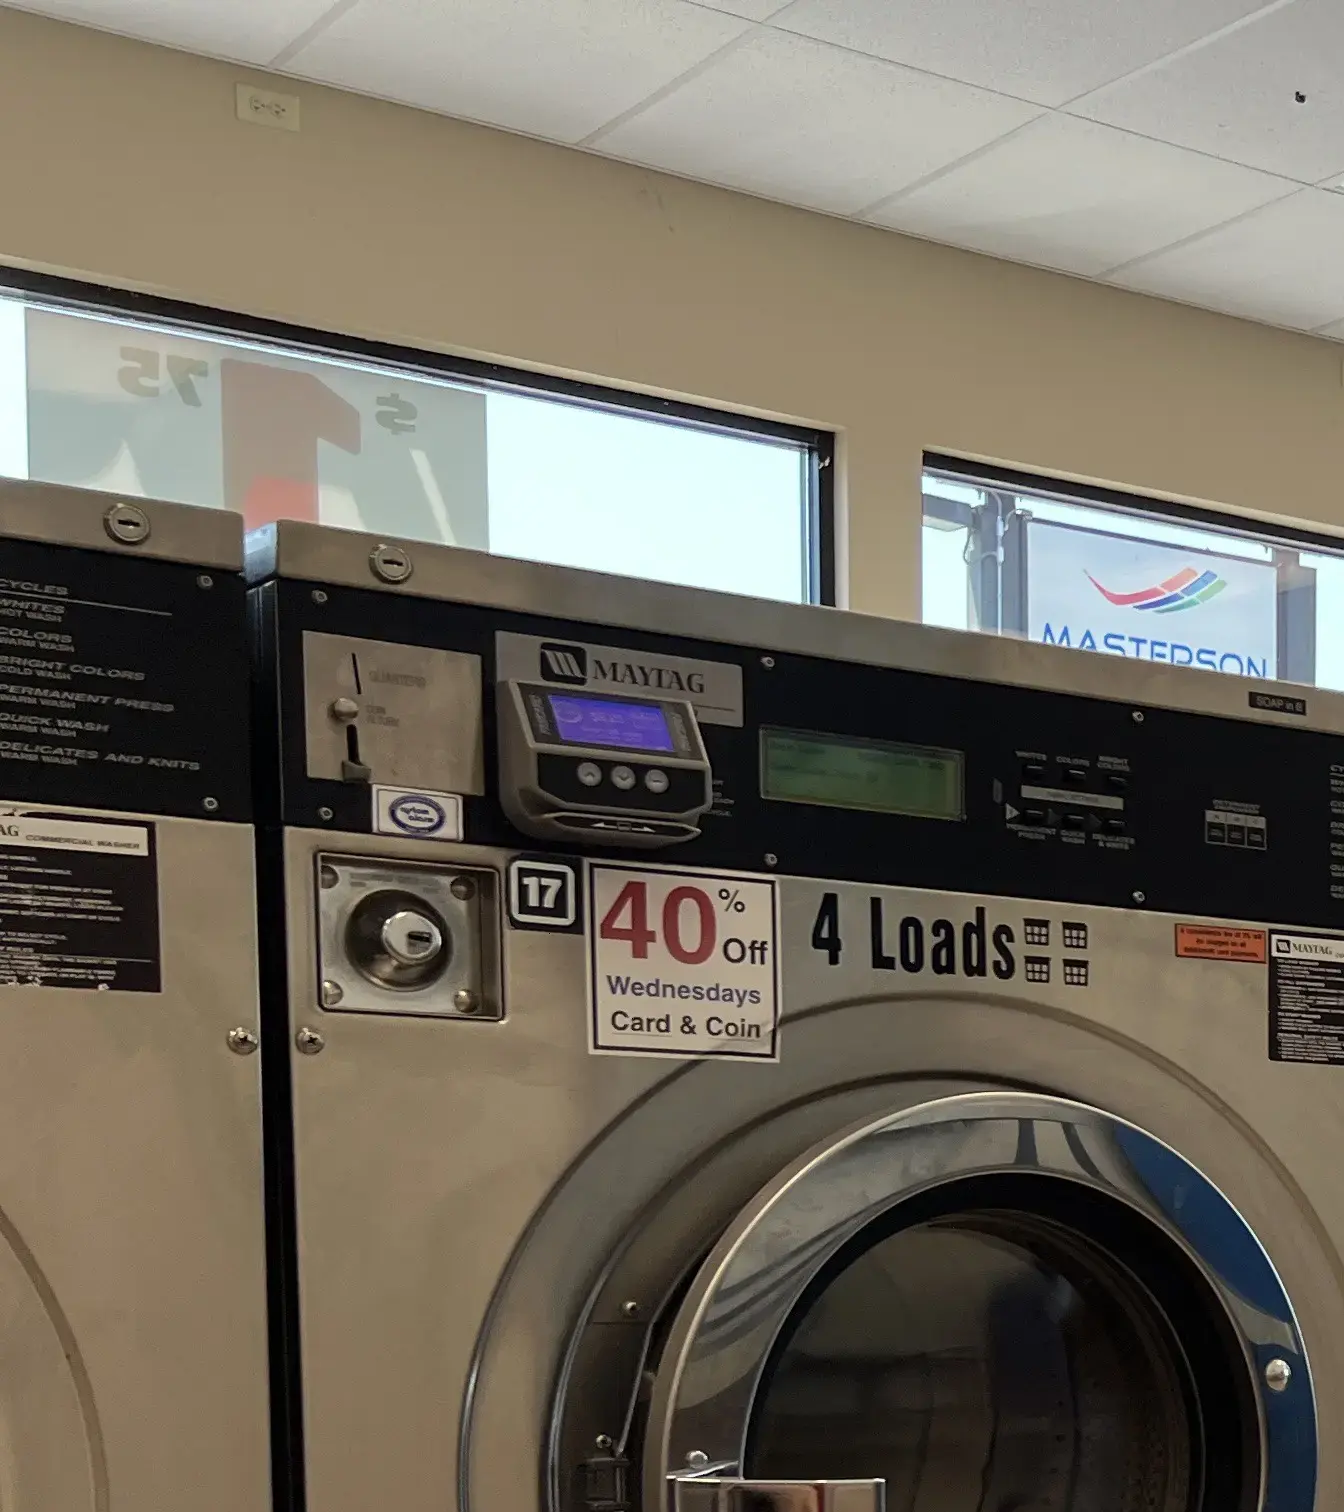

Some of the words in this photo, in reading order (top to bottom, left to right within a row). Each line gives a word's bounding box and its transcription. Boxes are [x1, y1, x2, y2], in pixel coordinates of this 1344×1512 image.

[1042, 622, 1267, 678] MASTERSON
[69, 664, 146, 681] COLORS
[592, 659, 706, 694] MAYTAG
[0, 740, 98, 760] DELICATES
[104, 752, 144, 765] AND
[147, 757, 200, 771] KNITS
[521, 876, 562, 909] 17
[722, 937, 768, 965] Off
[812, 892, 842, 966] 4
[869, 896, 1016, 980] Loads
[1292, 942, 1333, 956] MAYTAG
[606, 975, 761, 1008] Wednesdays
[611, 1010, 671, 1034] Card
[680, 1015, 697, 1035] &
[706, 1016, 761, 1038] Coin
